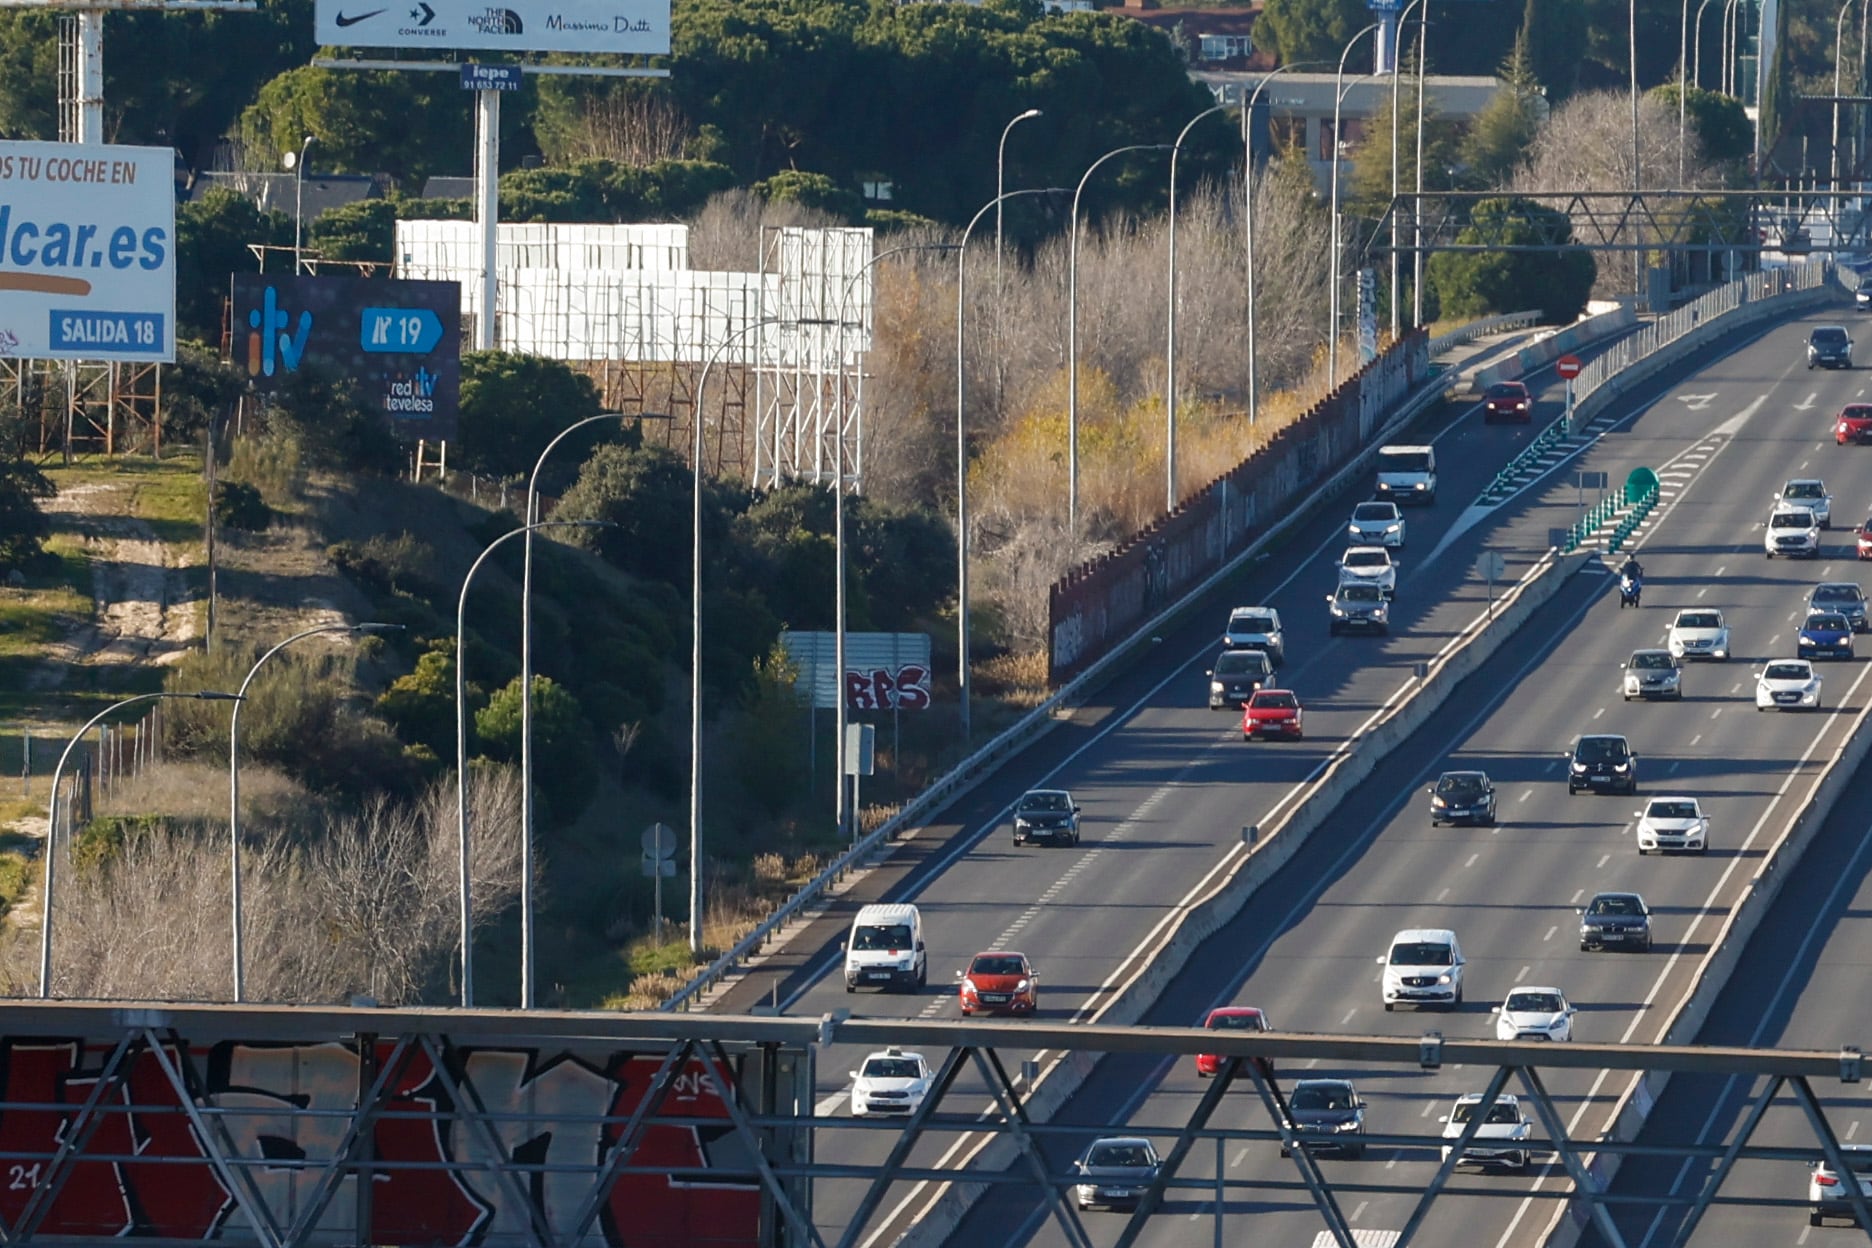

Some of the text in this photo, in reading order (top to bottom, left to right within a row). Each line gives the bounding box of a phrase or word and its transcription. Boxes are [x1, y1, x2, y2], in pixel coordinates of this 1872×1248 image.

[486, 7, 505, 17] THE
[468, 16, 505, 26] NORTH
[546, 15, 652, 33] Massimo Dutti
[399, 28, 446, 37] CONVERSE
[479, 25, 505, 35] FACE
[19, 158, 41, 180] TU
[46, 159, 107, 182] COCHE
[112, 161, 136, 184] EN
[62, 318, 154, 345] SALIDA 18
[248, 286, 312, 377] itv
[400, 317, 422, 345] 19
[391, 380, 412, 396] red
